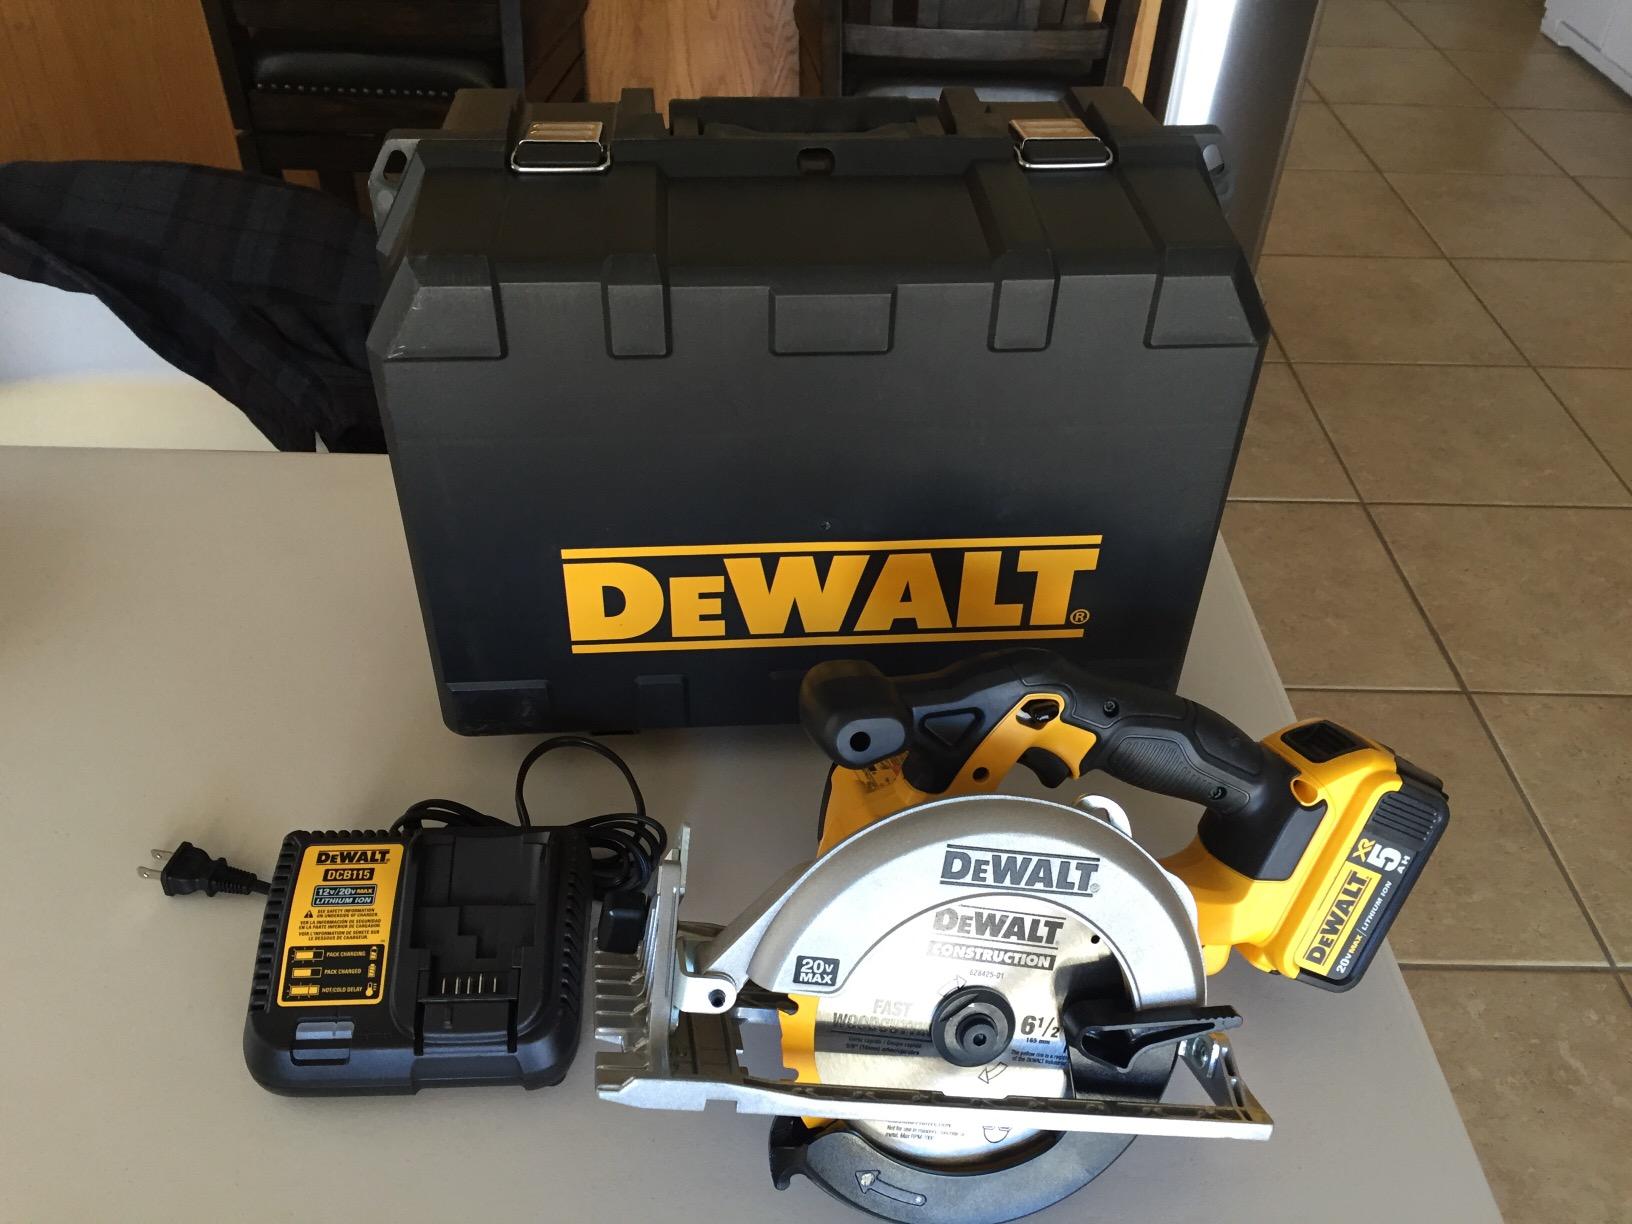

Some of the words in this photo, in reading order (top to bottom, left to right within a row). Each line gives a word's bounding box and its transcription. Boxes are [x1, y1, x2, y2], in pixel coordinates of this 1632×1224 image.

[1366, 843, 1402, 872] 5
[1397, 855, 1411, 875] AH
[327, 869, 371, 880] DCB115
[315, 897, 353, 905] LITHIUM
[1348, 934, 1363, 954] MAX
[1361, 897, 1384, 932] LITHIUM
[1380, 880, 1393, 897] ION
[932, 942, 1052, 968] CONSTRUCTION
[799, 972, 833, 984] MAX
[873, 998, 913, 1017] FAST
